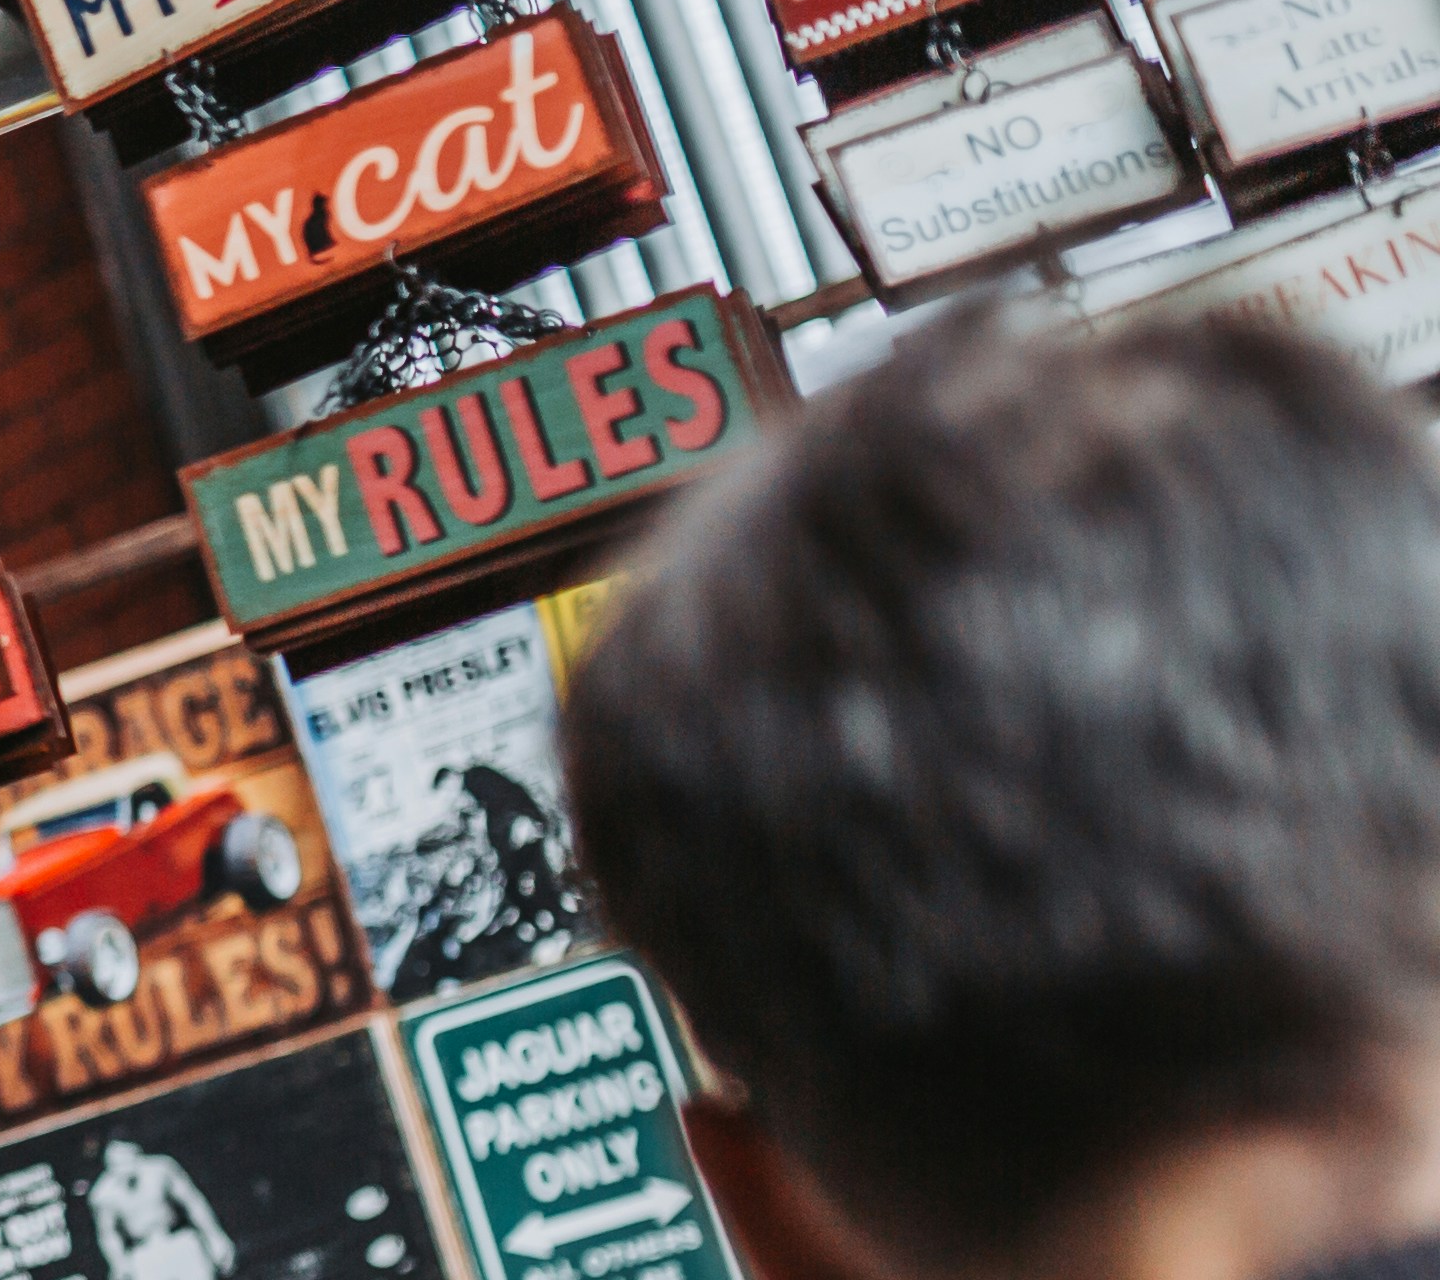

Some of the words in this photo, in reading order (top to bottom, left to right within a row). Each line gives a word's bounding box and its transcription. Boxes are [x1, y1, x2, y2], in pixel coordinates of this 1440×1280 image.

[175, 184, 307, 301] MY
[329, 32, 584, 245] cat
[965, 115, 1043, 166] NO
[880, 136, 1174, 256] Substitutions
[233, 457, 353, 583] MY
[347, 322, 731, 558] RULES
[400, 635, 533, 698] PRESLEY
[40, 906, 354, 1094] RULES!
[455, 1001, 643, 1105] JAGUAR
[466, 1060, 666, 1162] PARKING
[523, 1130, 642, 1205] ONLY
[582, 1219, 704, 1280] OTHERS
